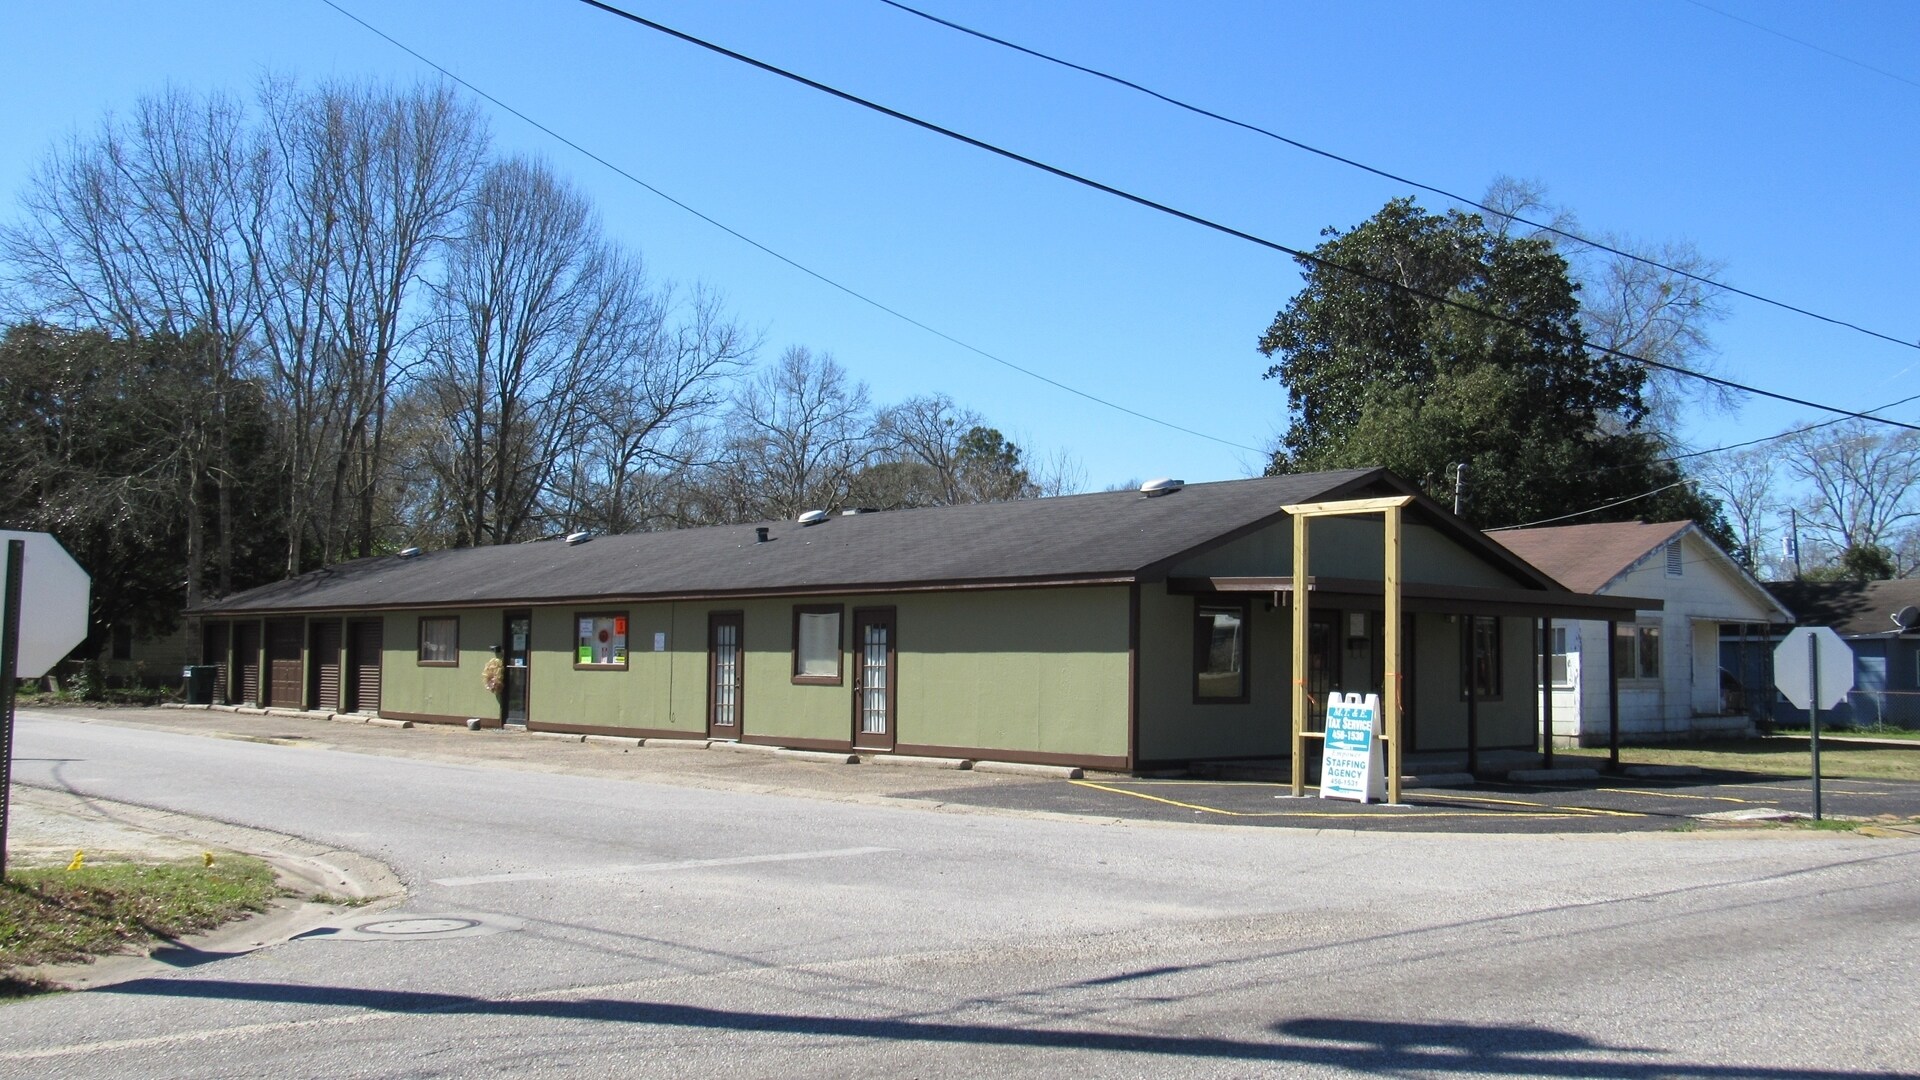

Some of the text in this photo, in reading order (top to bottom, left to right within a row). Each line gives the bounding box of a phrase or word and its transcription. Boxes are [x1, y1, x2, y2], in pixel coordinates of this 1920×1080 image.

[1328, 716, 1372, 731] TAX SERVICE
[1326, 756, 1366, 770] STAFFING
[1328, 766, 1362, 779] AGENCY
